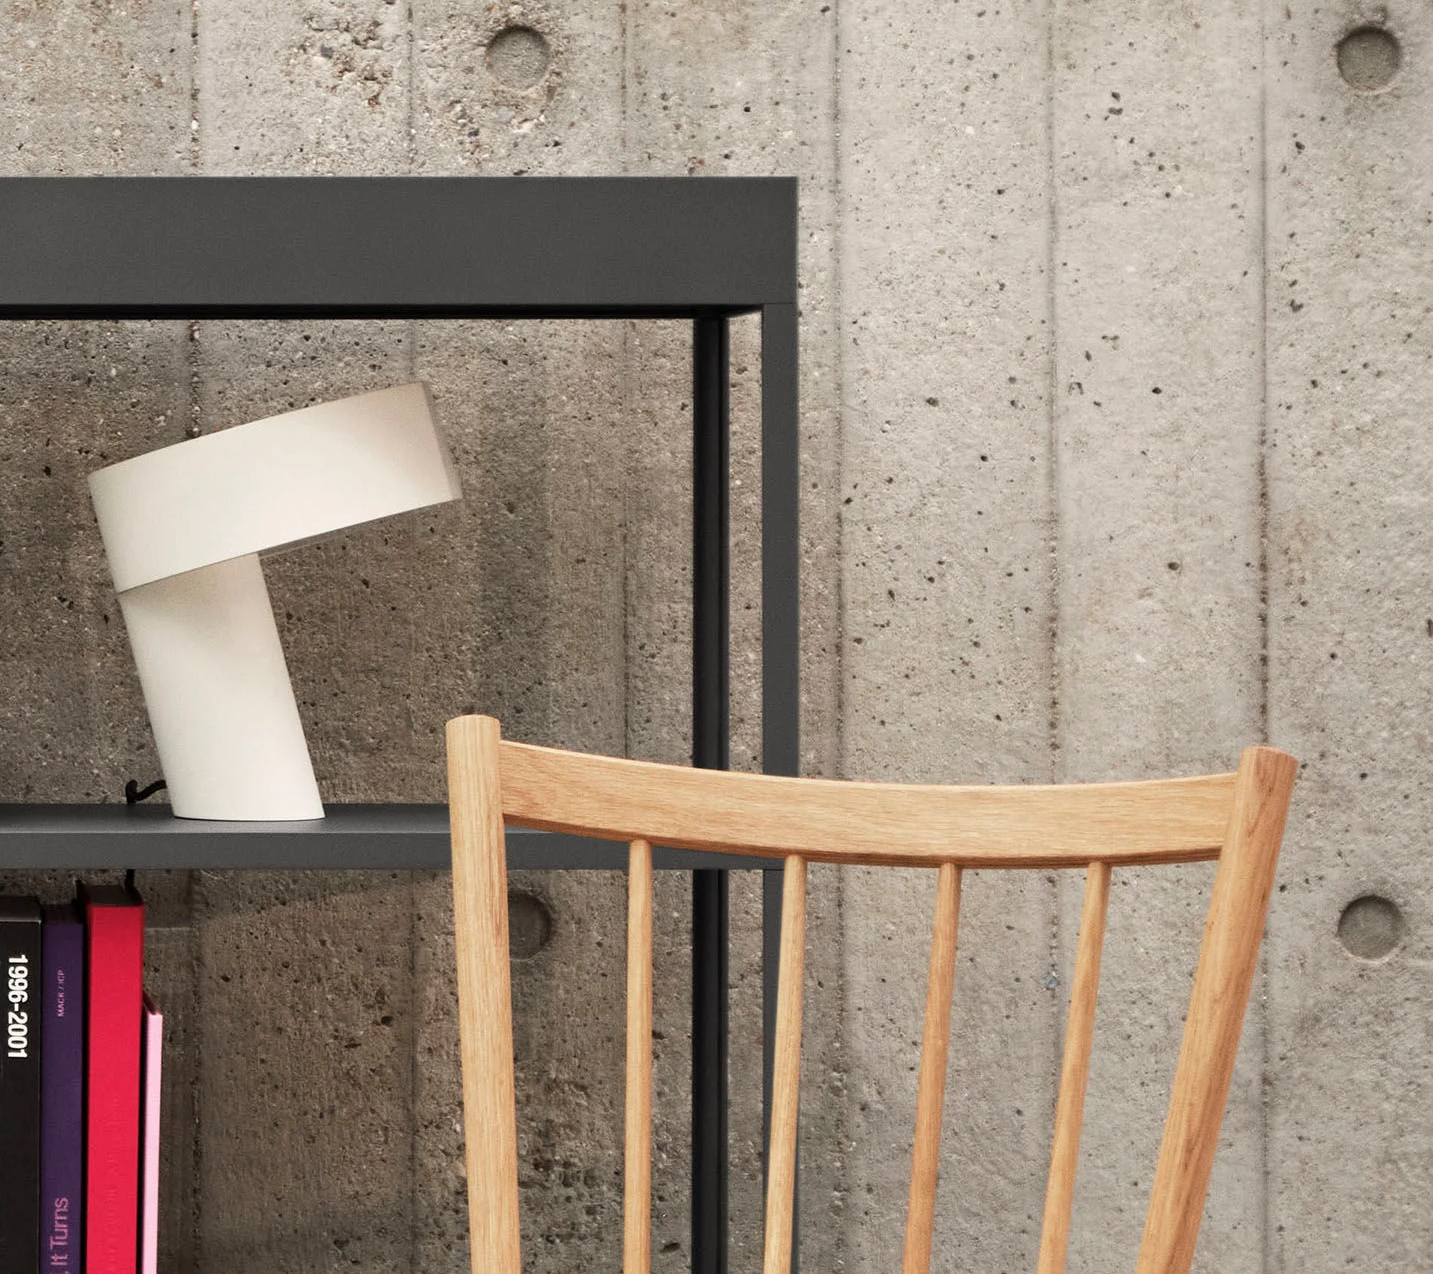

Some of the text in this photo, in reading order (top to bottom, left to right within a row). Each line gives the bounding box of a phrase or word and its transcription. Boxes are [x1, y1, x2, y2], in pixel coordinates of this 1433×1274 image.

[6, 954, 29, 1060] 1996-2001
[57, 992, 65, 1017] MACK
[50, 1198, 69, 1250] Turns
[50, 1254, 69, 1266] It
